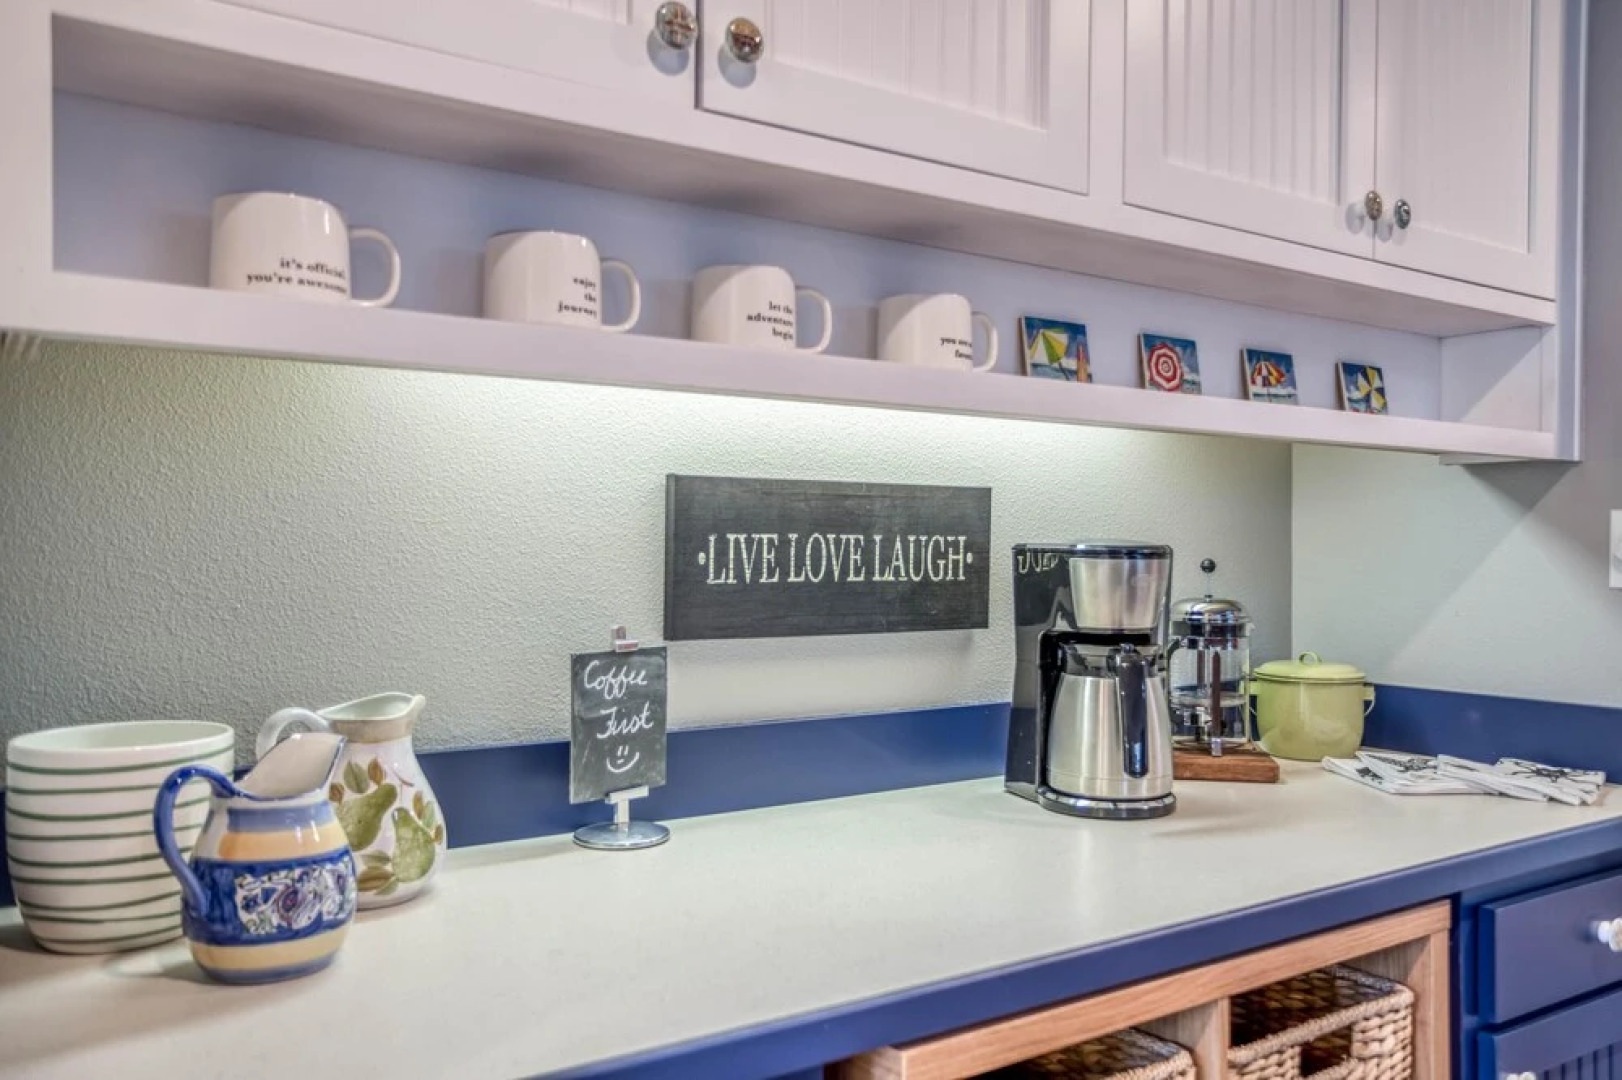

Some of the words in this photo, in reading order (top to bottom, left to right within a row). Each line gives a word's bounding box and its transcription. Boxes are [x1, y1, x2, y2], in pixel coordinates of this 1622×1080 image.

[246, 271, 293, 286] you're
[706, 533, 779, 584] LIVE
[787, 532, 866, 583] LOVE
[872, 534, 967, 582] LAUGH
[583, 660, 648, 700] Coffee
[597, 701, 654, 739] First
